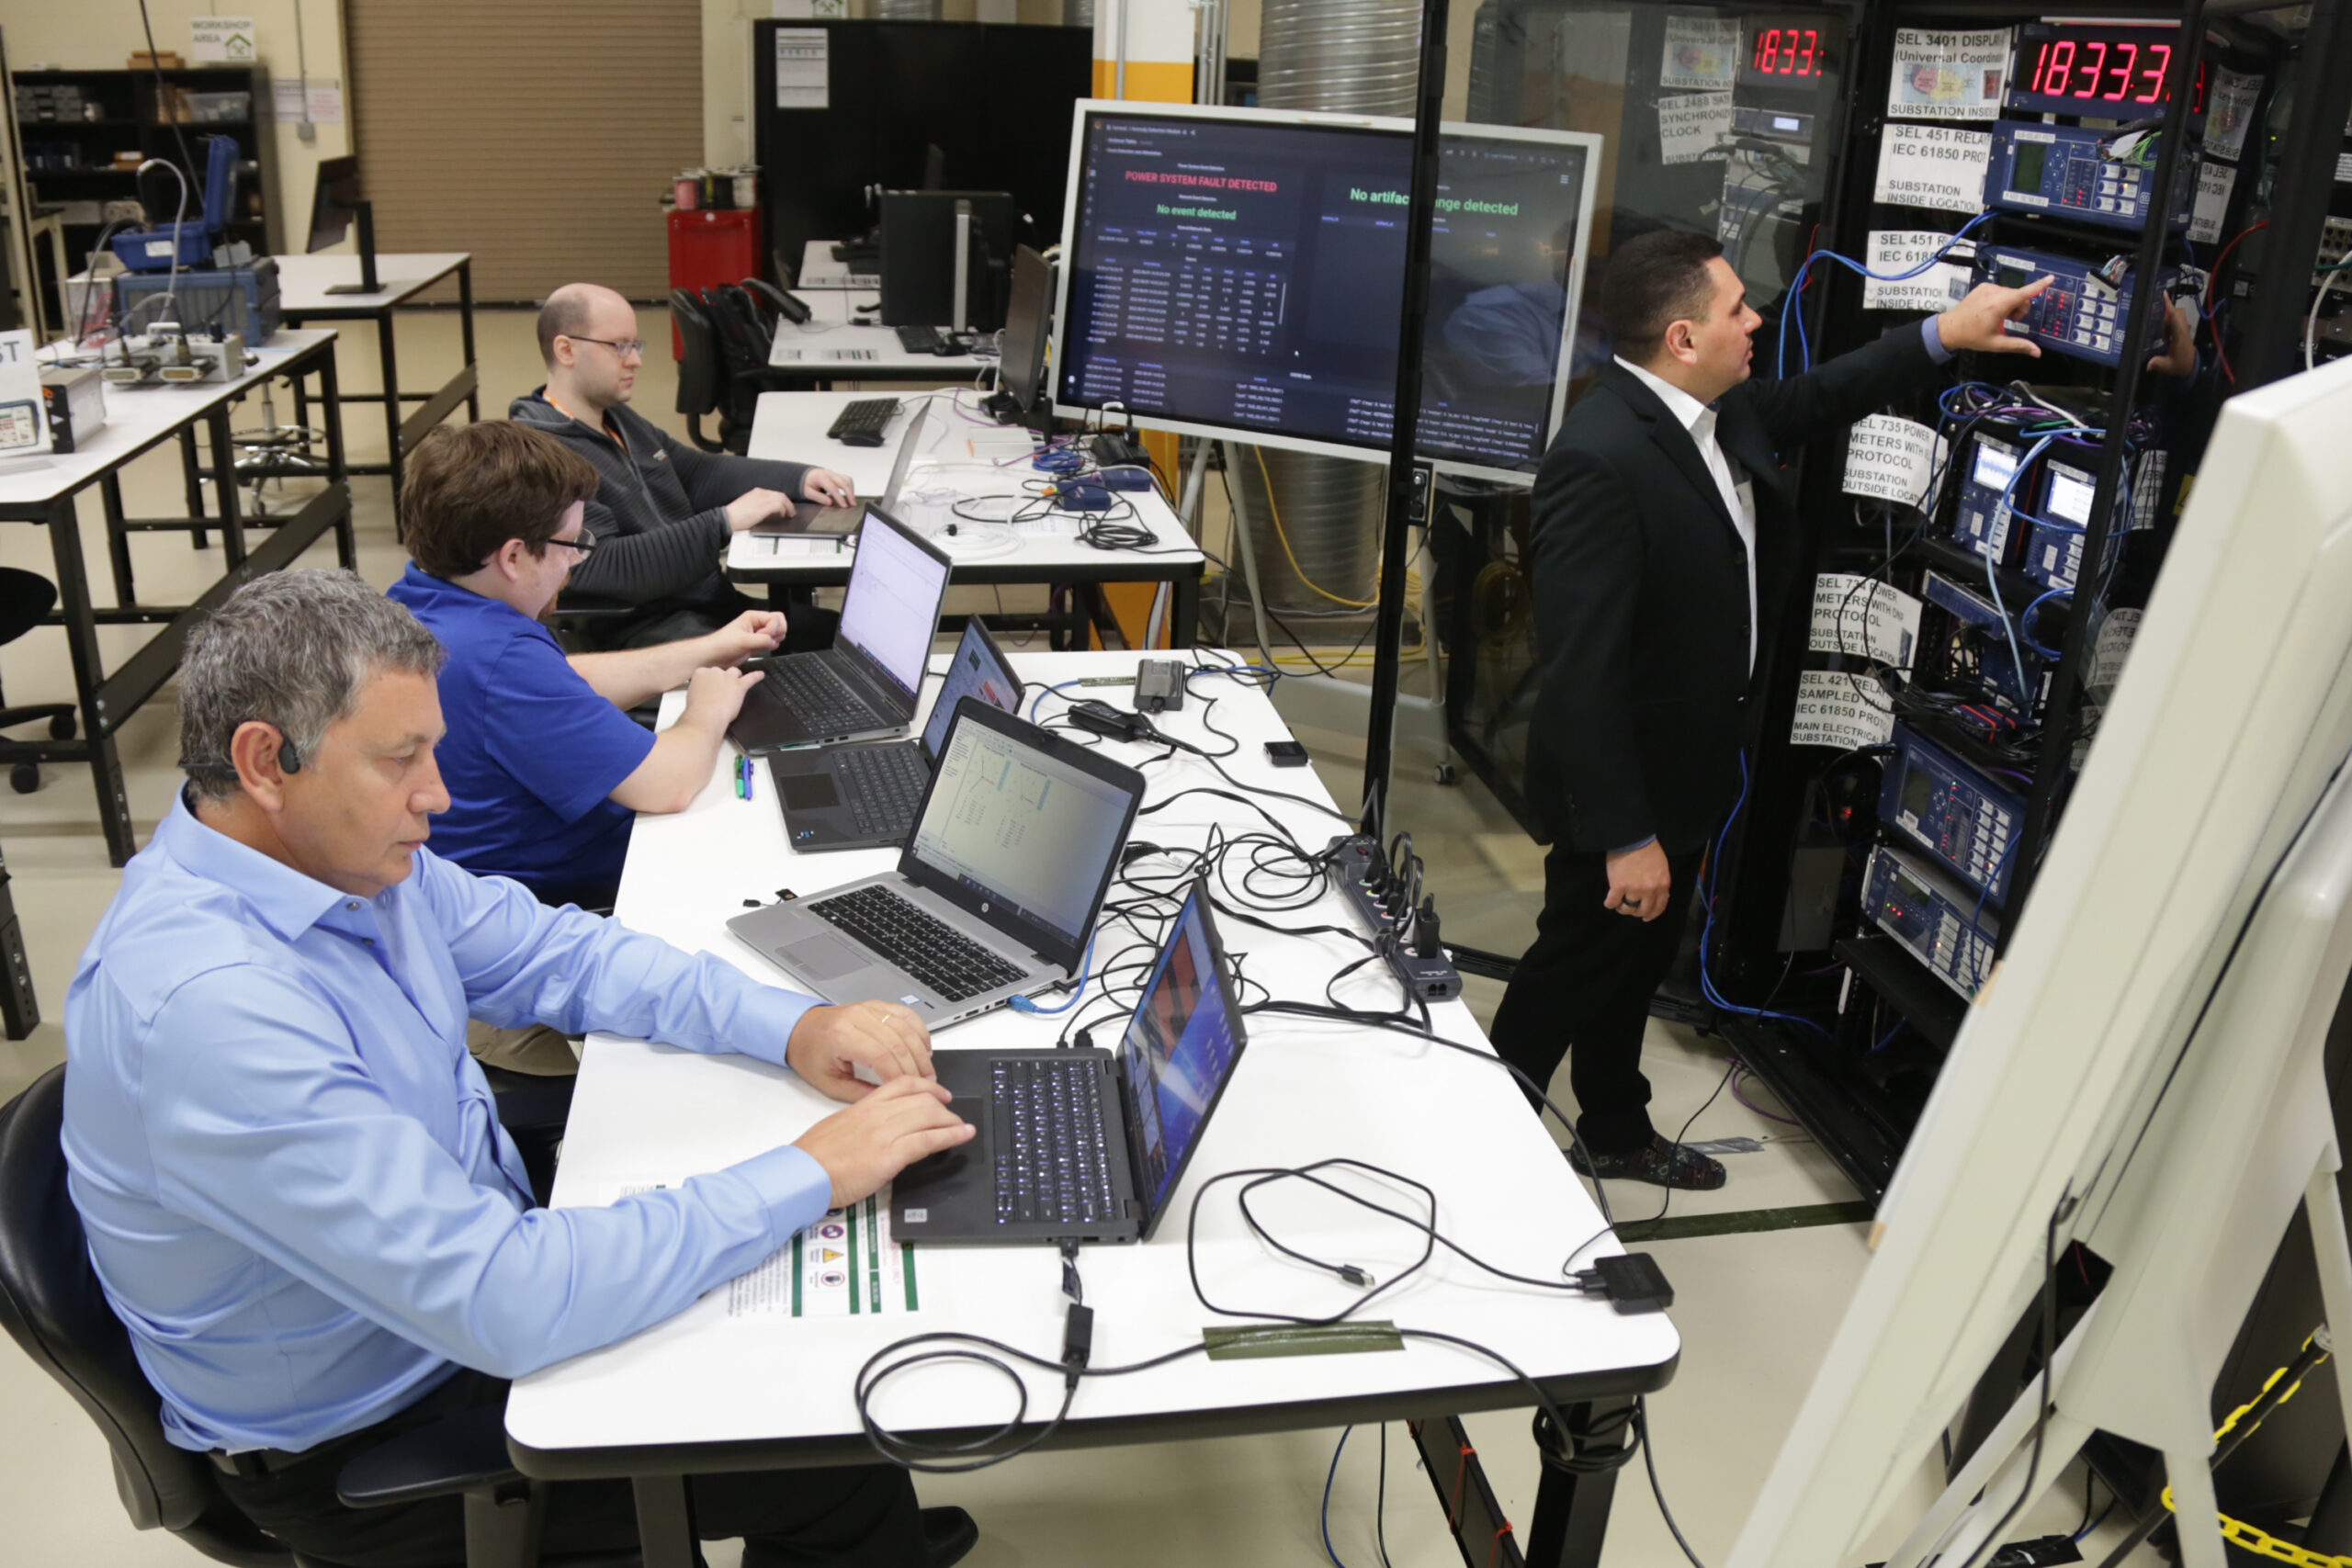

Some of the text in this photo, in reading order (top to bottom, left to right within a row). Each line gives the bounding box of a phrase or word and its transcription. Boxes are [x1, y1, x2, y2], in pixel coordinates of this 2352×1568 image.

[191, 20, 251, 29] WORKSHOP
[193, 34, 220, 43] AREA
[1896, 32, 1921, 45] SEL
[1927, 34, 1956, 46] 3401
[1659, 99, 1679, 111] SEL
[1891, 104, 1964, 116] SUBSTATION
[1662, 127, 1702, 138] CLOCK
[1895, 126, 1922, 139] SEL
[1927, 129, 1950, 141] 451
[1893, 143, 1916, 155] IEC
[1920, 145, 1959, 160] 61850
[1125, 171, 1277, 192] POWER SYSTEM FAULT DETECTED
[1889, 179, 1961, 196] SUBSTATION
[1350, 187, 1367, 200] No
[1370, 190, 1409, 205] artifac
[1464, 198, 1519, 216] detected
[1887, 193, 1975, 211] INSIDE LOCATION
[1157, 204, 1237, 220] No event detected
[1881, 234, 1905, 245] SEL
[1910, 235, 1933, 245] 451
[1879, 251, 1901, 262] IEC
[1876, 299, 1914, 310] INSIDE
[1881, 420, 1901, 433] 735
[1904, 424, 1929, 441] POWER
[1850, 433, 1924, 456] METERS WITH
[1848, 448, 1913, 469] PROTOCOL
[1844, 468, 1907, 487] SUBSTATION
[1842, 480, 1888, 495] OUTSIDE
[1817, 578, 1841, 588] SEL
[1815, 593, 1868, 607] METERS
[1871, 599, 1891, 615] WITH
[1815, 608, 1882, 626] PROTOCOL
[1810, 627, 1876, 644] SUBSTATION
[1802, 674, 1824, 684] SEL
[1828, 674, 1849, 686] 421
[1799, 689, 1860, 704] SAMPLED
[1797, 704, 1816, 714] IEC
[1820, 705, 1855, 717] 61850
[1794, 722, 1819, 730] MAIN
[1792, 733, 1858, 747] SUBSTATION
